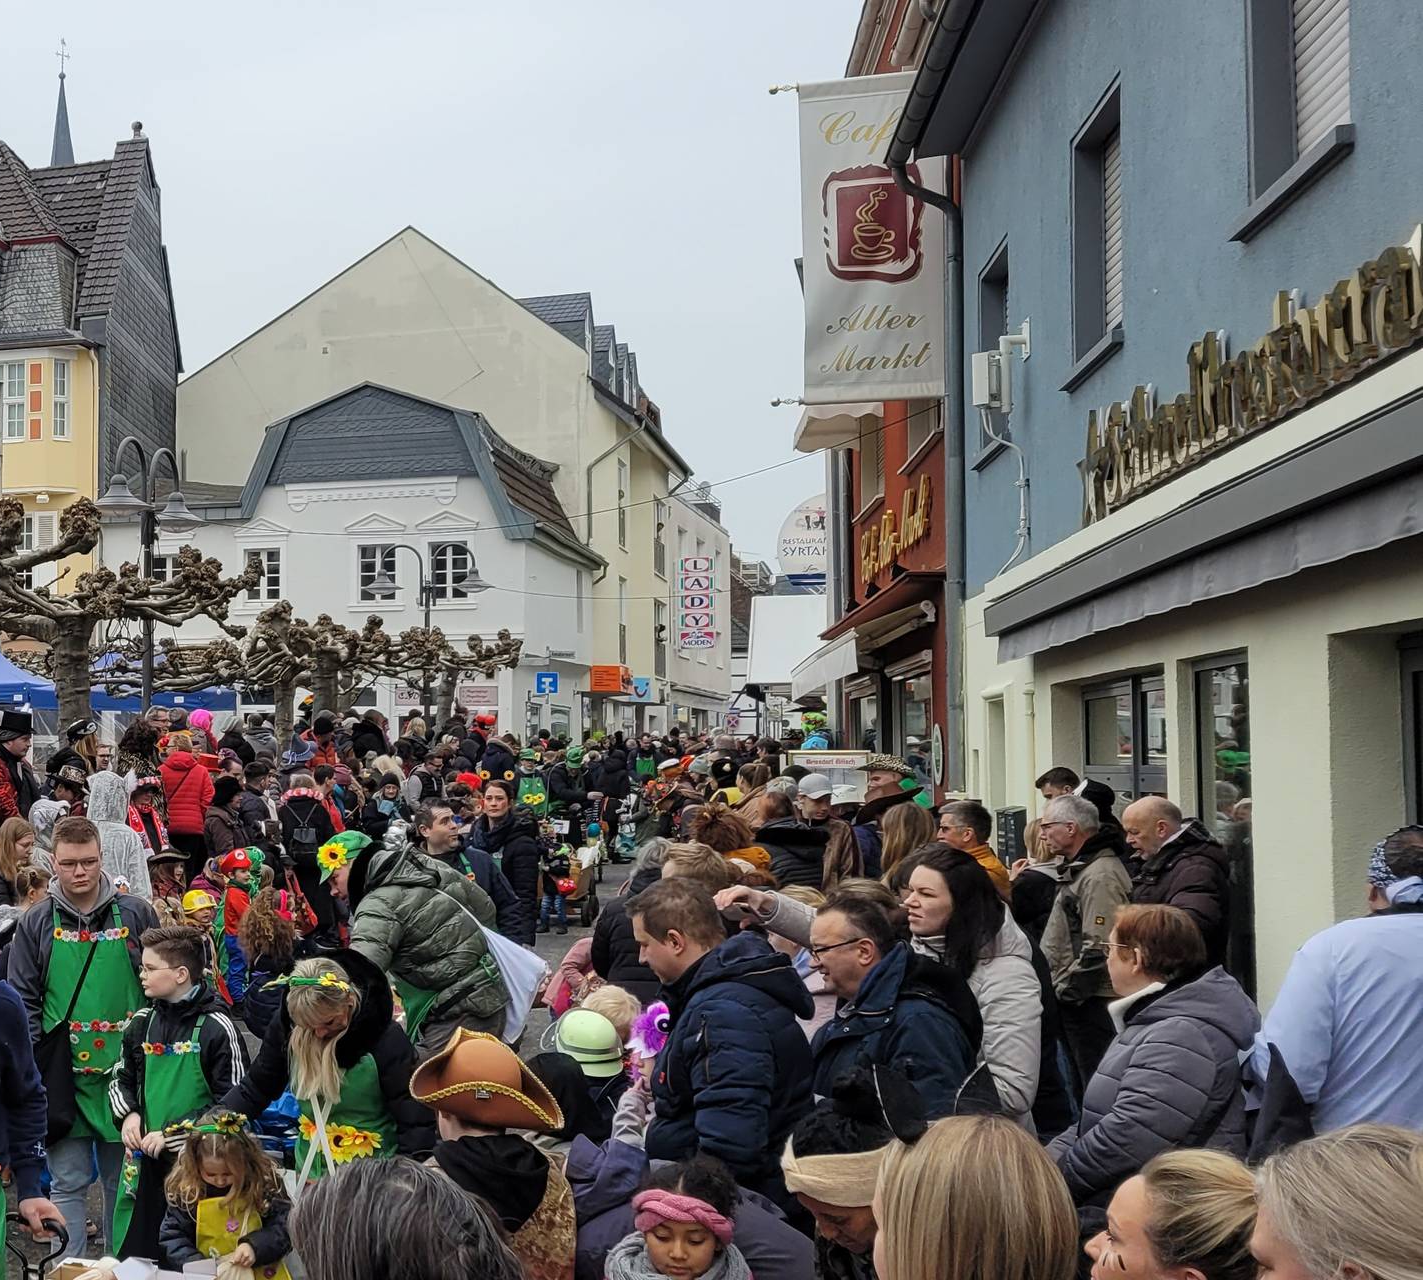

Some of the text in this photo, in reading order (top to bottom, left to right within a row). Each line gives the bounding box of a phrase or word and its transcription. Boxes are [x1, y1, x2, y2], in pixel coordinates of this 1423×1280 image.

[819, 106, 902, 155] Caf
[826, 304, 925, 335] Alter
[820, 342, 931, 373] Markt
[689, 559, 704, 626] LADY
